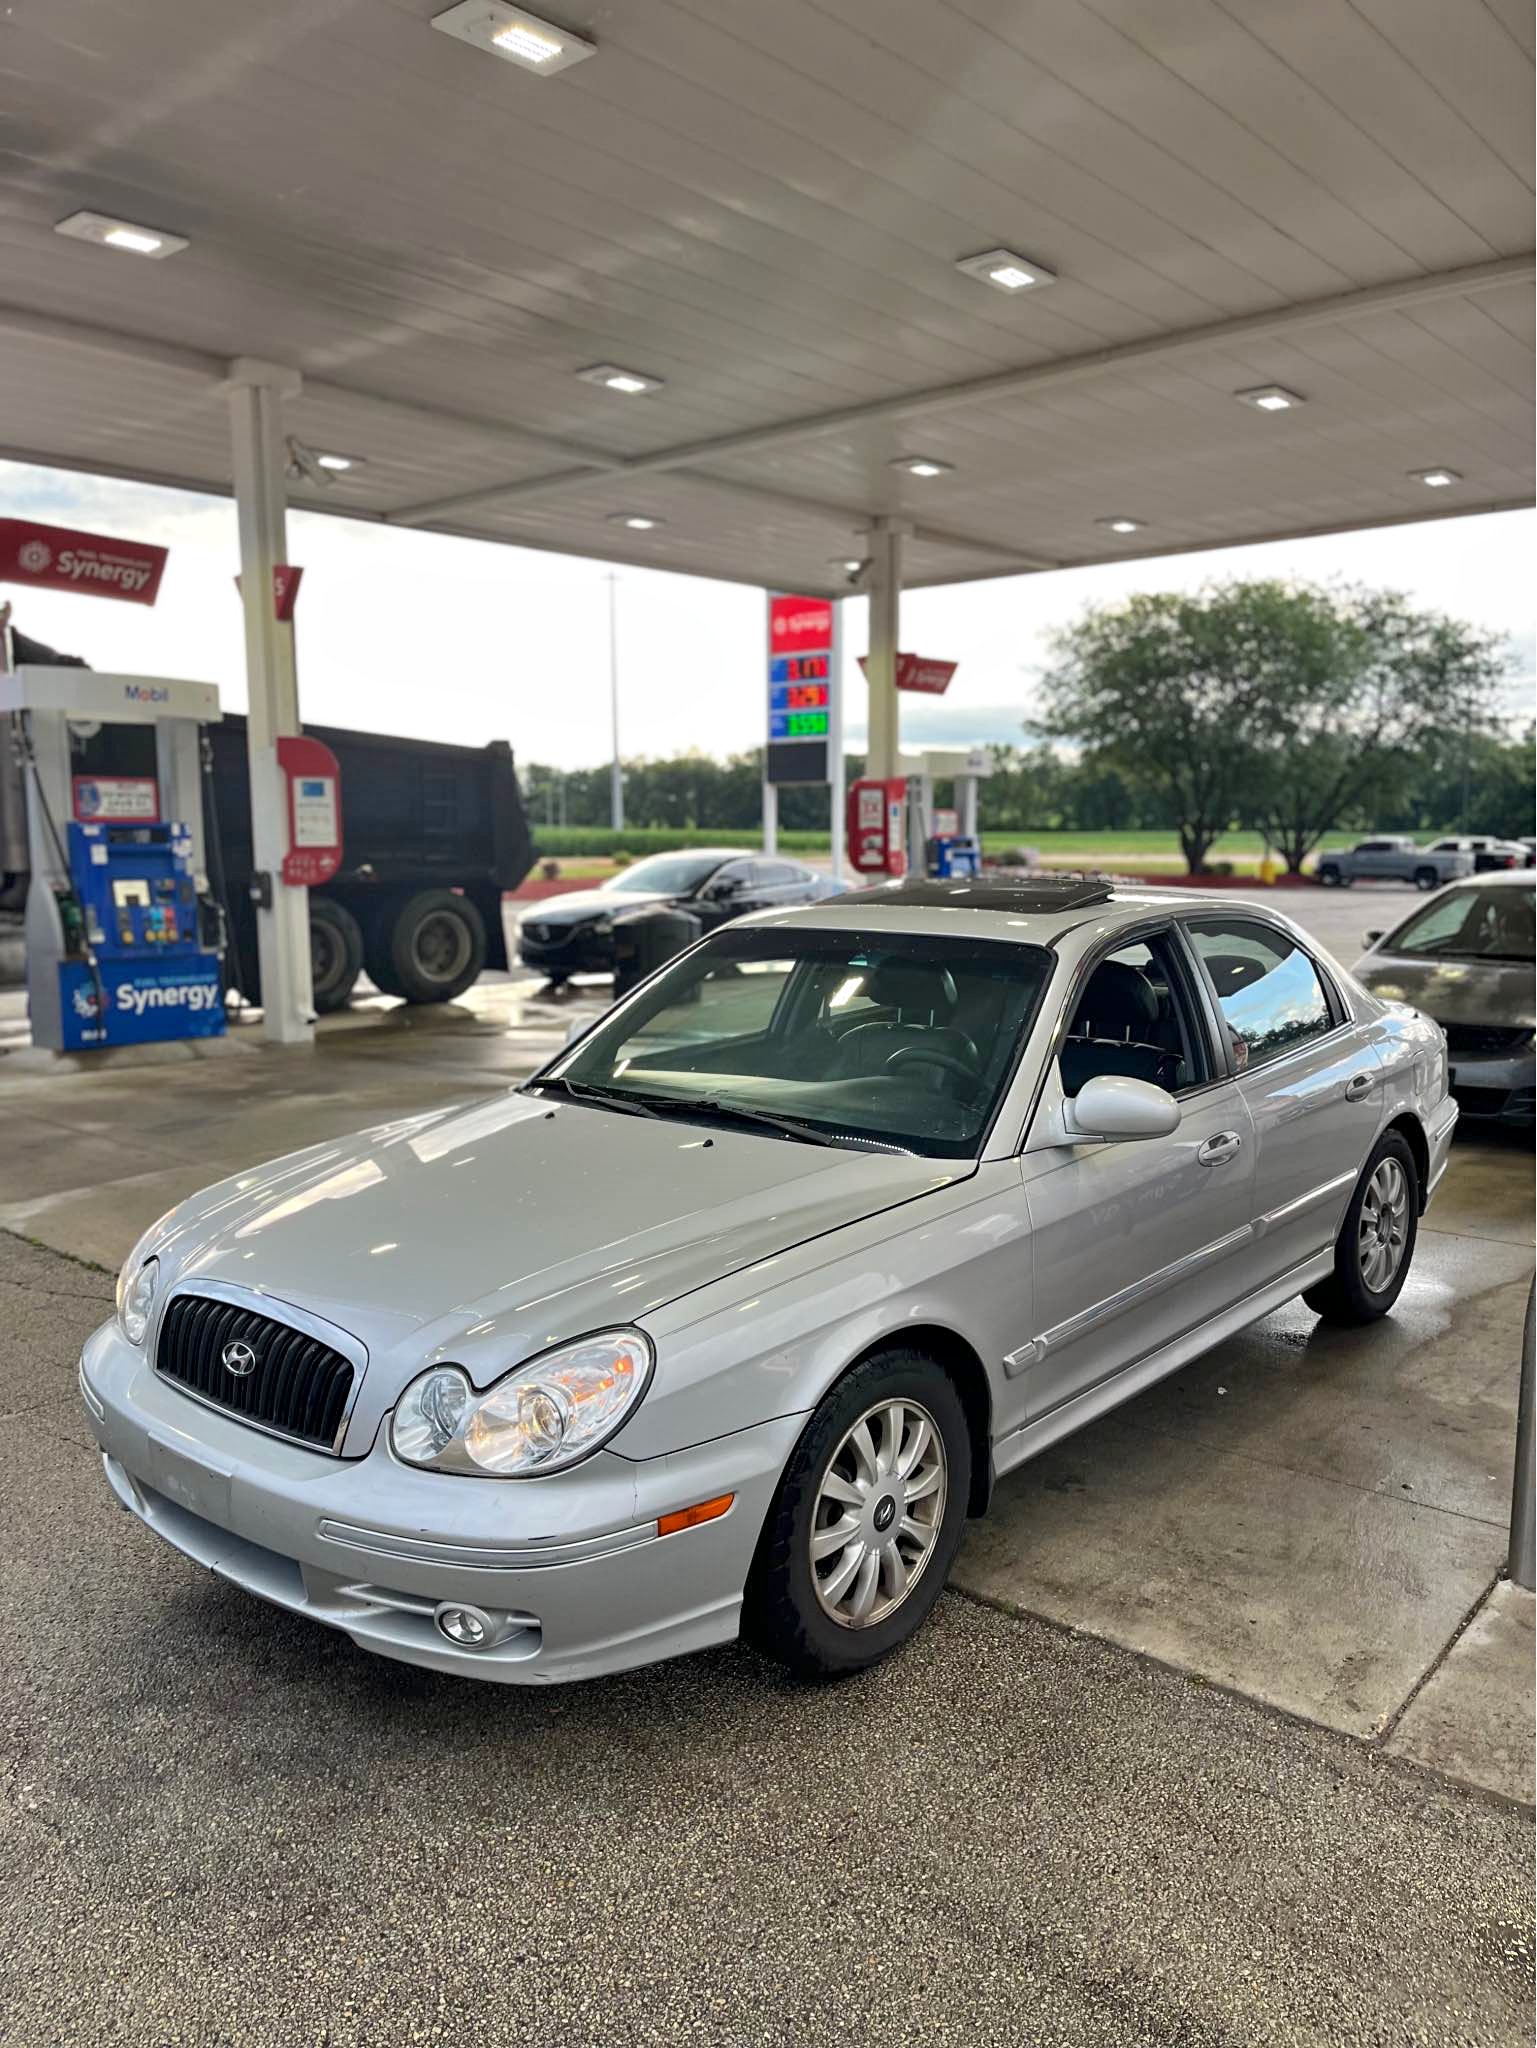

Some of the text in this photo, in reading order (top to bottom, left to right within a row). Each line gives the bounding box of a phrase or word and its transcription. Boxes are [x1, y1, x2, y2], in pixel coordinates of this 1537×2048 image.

[56, 550, 151, 591] Synergy
[125, 685, 169, 702] Mobil
[116, 983, 218, 1016] Synergy
